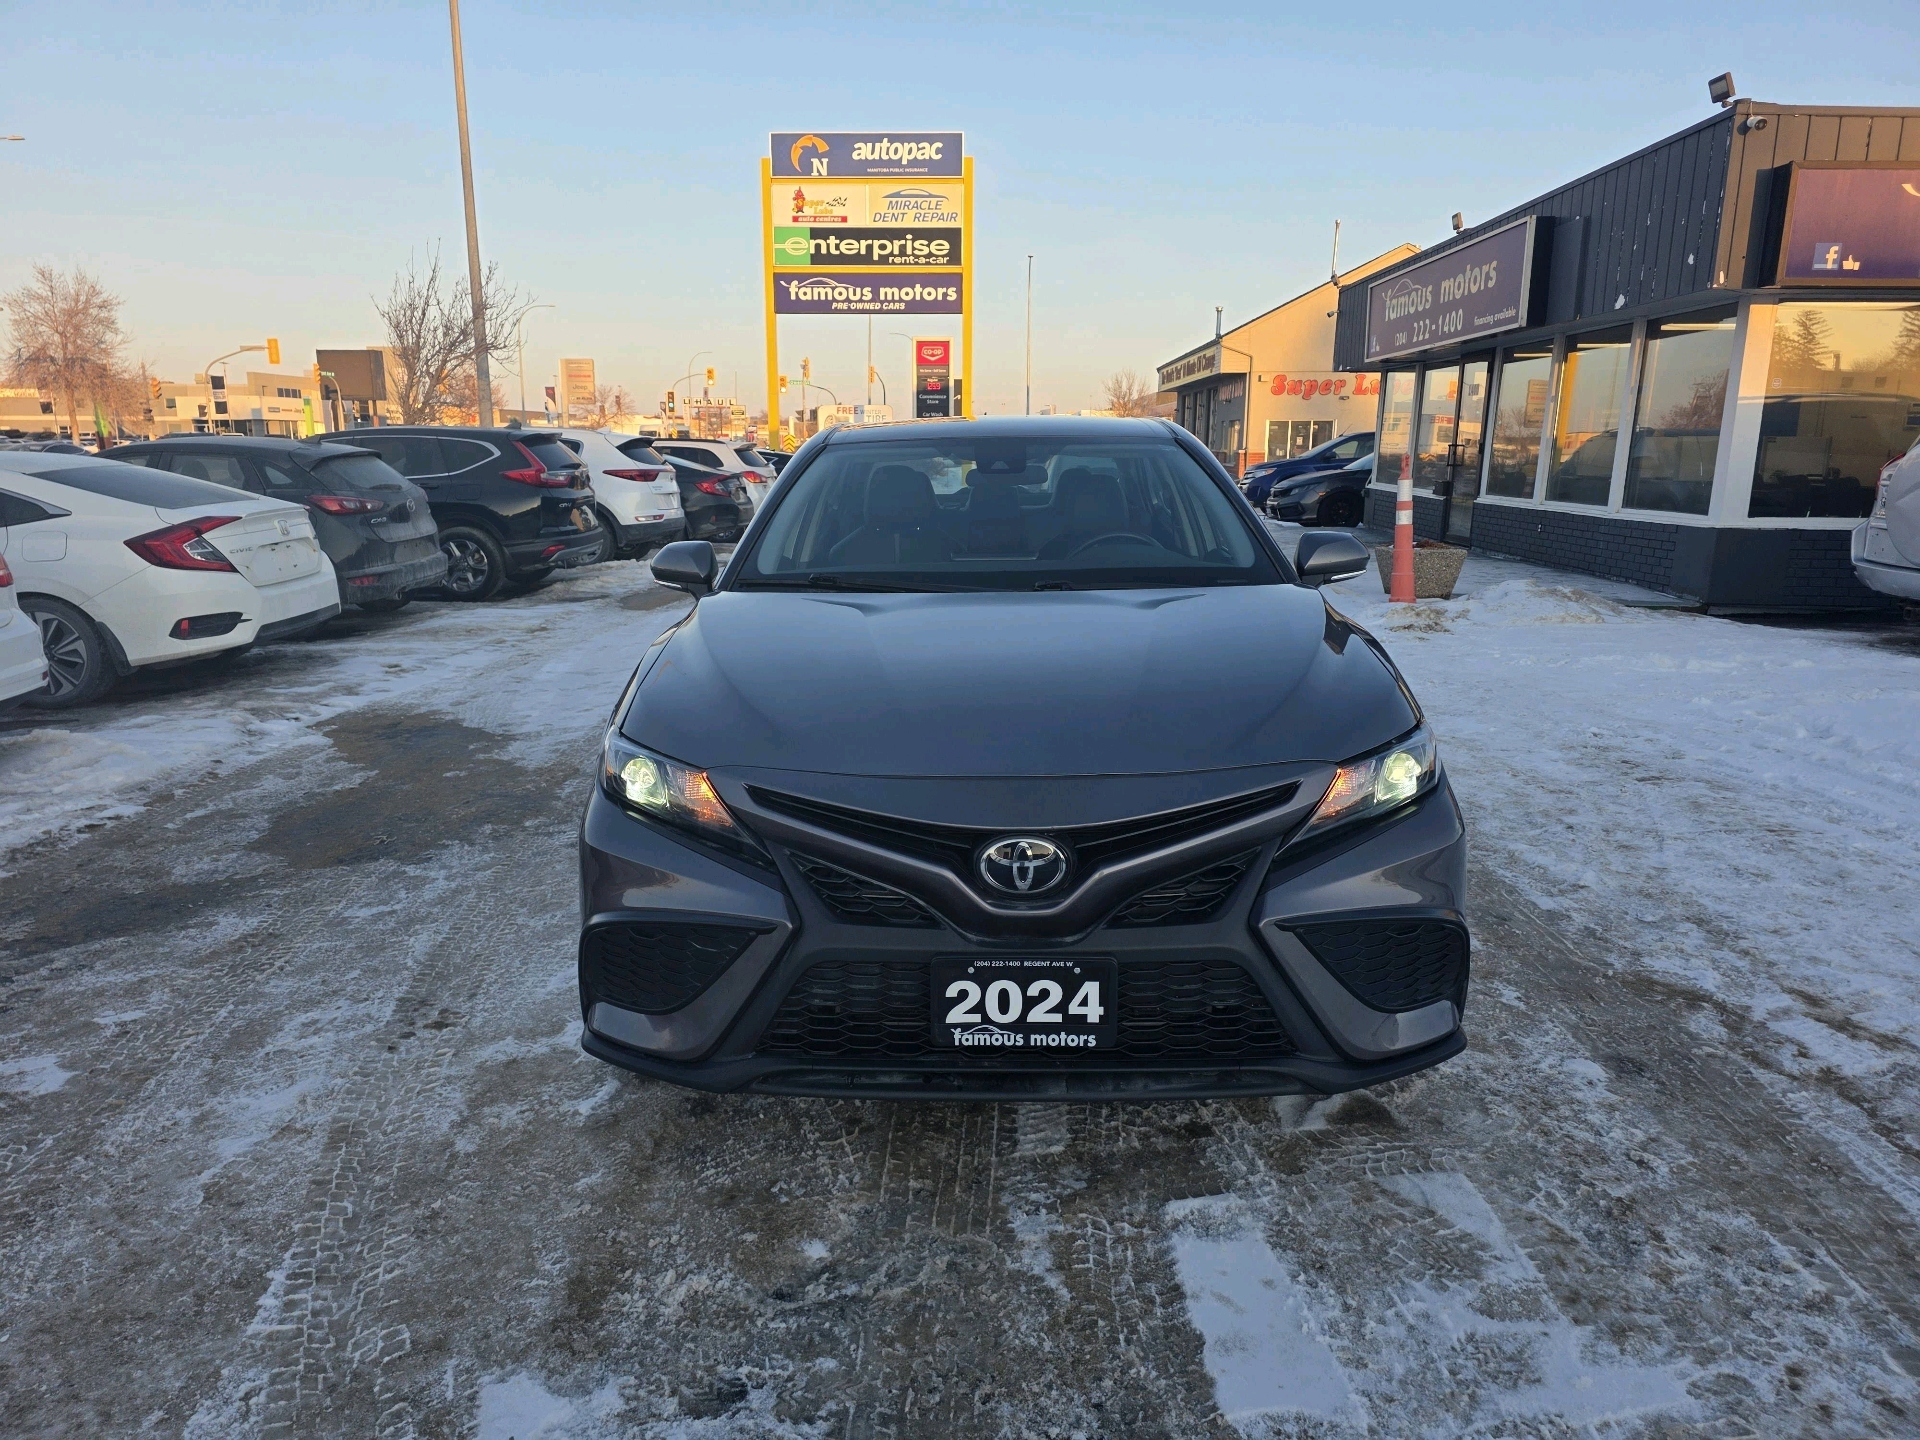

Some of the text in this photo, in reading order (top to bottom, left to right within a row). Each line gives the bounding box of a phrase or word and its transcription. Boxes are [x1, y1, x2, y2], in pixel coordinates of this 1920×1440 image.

[852, 138, 943, 165] autopac
[887, 200, 943, 210] MIRACLE
[873, 212, 958, 222] DENT REPAIR
[784, 234, 950, 260] enterprise
[889, 255, 949, 264] rent-a-car
[788, 279, 957, 301] famous motors
[1385, 260, 1498, 322] famous motors
[832, 302, 905, 310] PRE-OWNED CARS
[1474, 306, 1516, 327] financing available
[1413, 309, 1464, 343] 222-1400
[1271, 374, 1347, 400] Super
[836, 406, 859, 415] FREE
[229, 546, 253, 554] CIVIC
[945, 979, 1105, 1024] 2024
[953, 1028, 1097, 1047] famous motors
